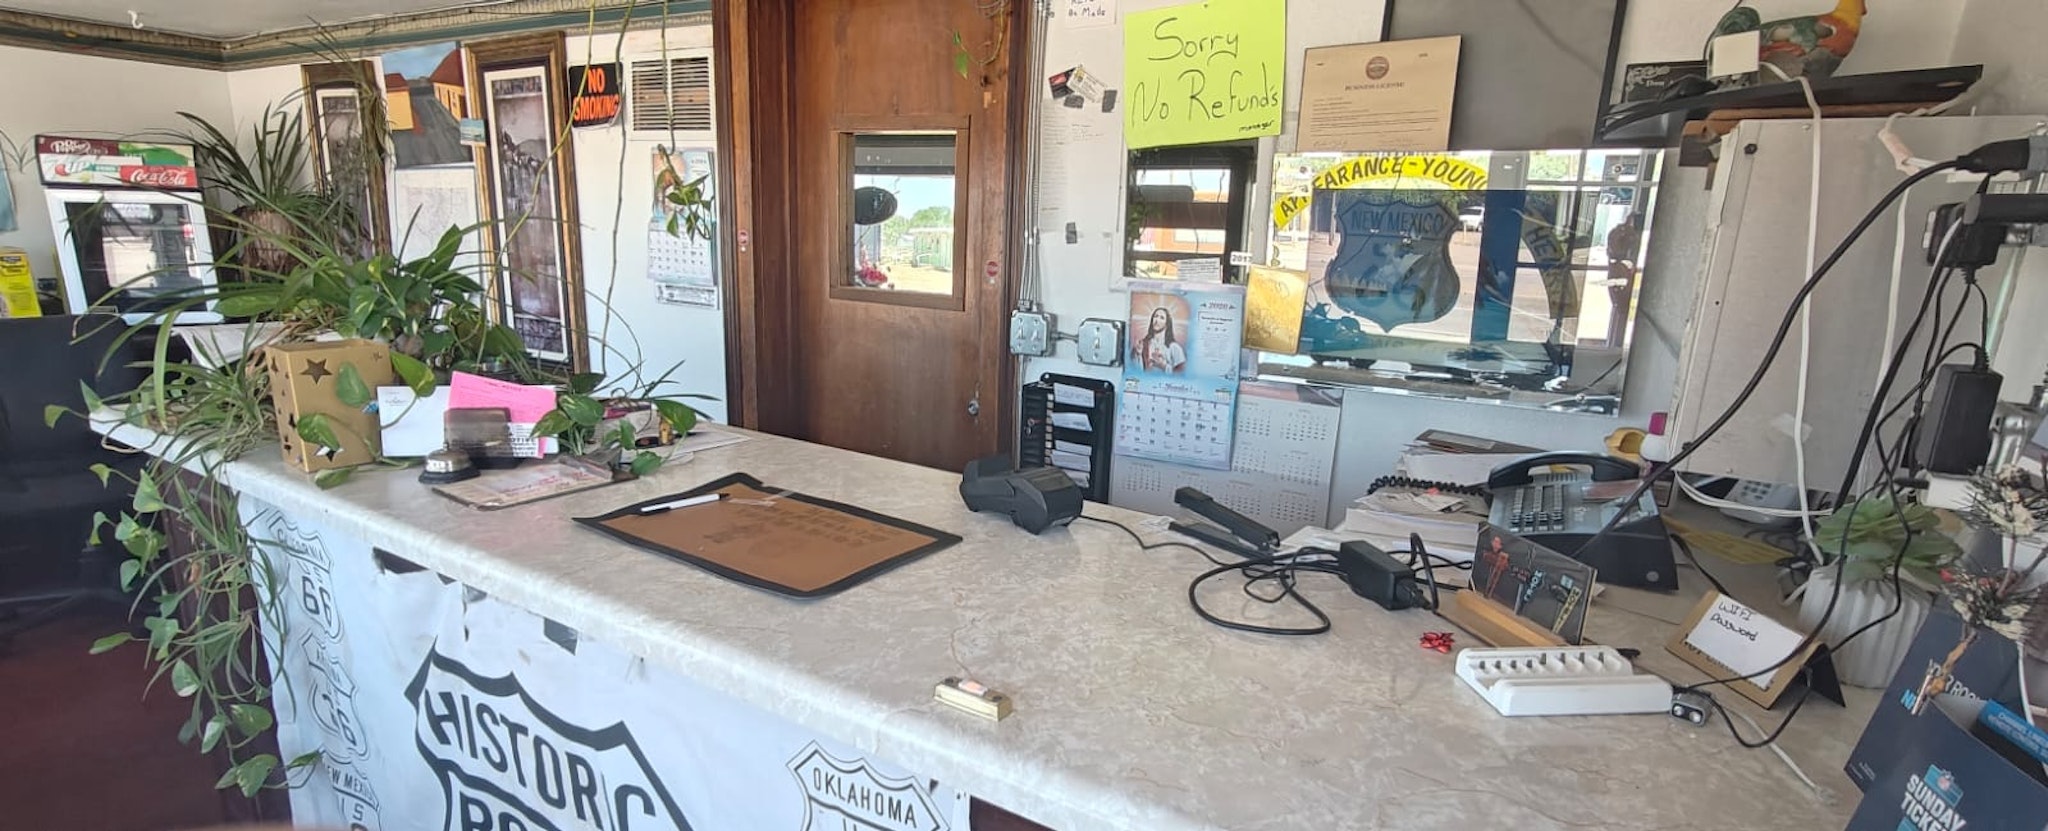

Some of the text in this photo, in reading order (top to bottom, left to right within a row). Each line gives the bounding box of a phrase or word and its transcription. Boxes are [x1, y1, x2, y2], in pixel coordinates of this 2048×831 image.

[1148, 17, 1239, 67] Sorry
[587, 67, 606, 93] NO
[1131, 77, 1170, 128] No
[573, 93, 621, 121] SMOKING
[302, 575, 333, 628] 66
[813, 767, 918, 829] OKLAHOMA
[1906, 773, 1967, 831] SUNDAY
